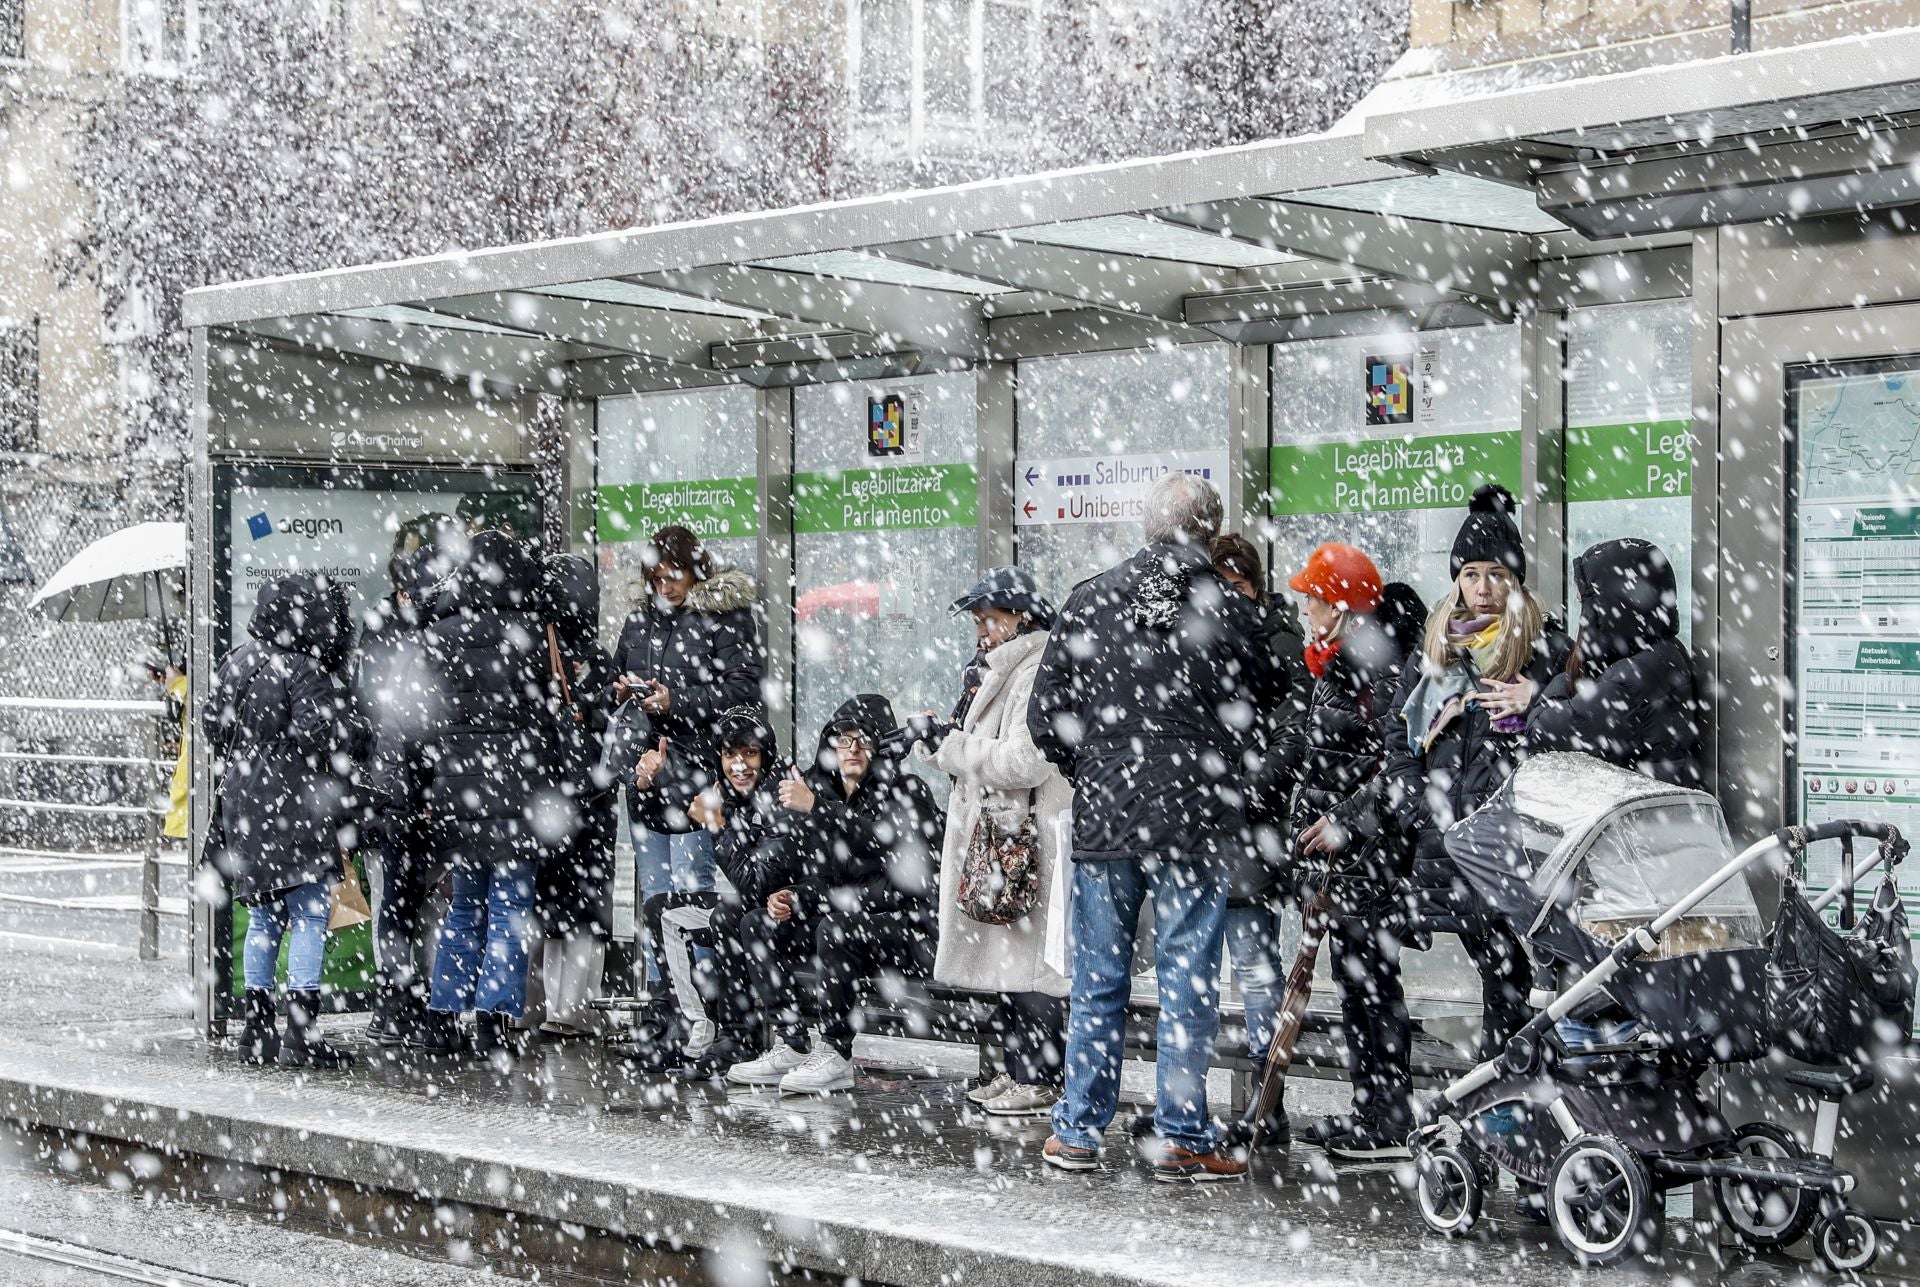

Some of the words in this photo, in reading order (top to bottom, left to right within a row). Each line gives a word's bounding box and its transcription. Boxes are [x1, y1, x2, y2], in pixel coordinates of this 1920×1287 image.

[347, 433, 376, 446] Clear
[379, 434, 423, 446] Channel
[1334, 443, 1465, 480] Legebiltzarra
[843, 472, 941, 502] Legebiltzarra
[1335, 480, 1465, 508] Parlamento
[642, 485, 730, 514] Legebiltzarra
[843, 503, 941, 528] Parlamento
[1861, 513, 1886, 521] baiondo
[280, 518, 343, 539] aegon
[245, 566, 292, 578] Seguros
[341, 568, 361, 576] con
[630, 742, 648, 753] MUL
